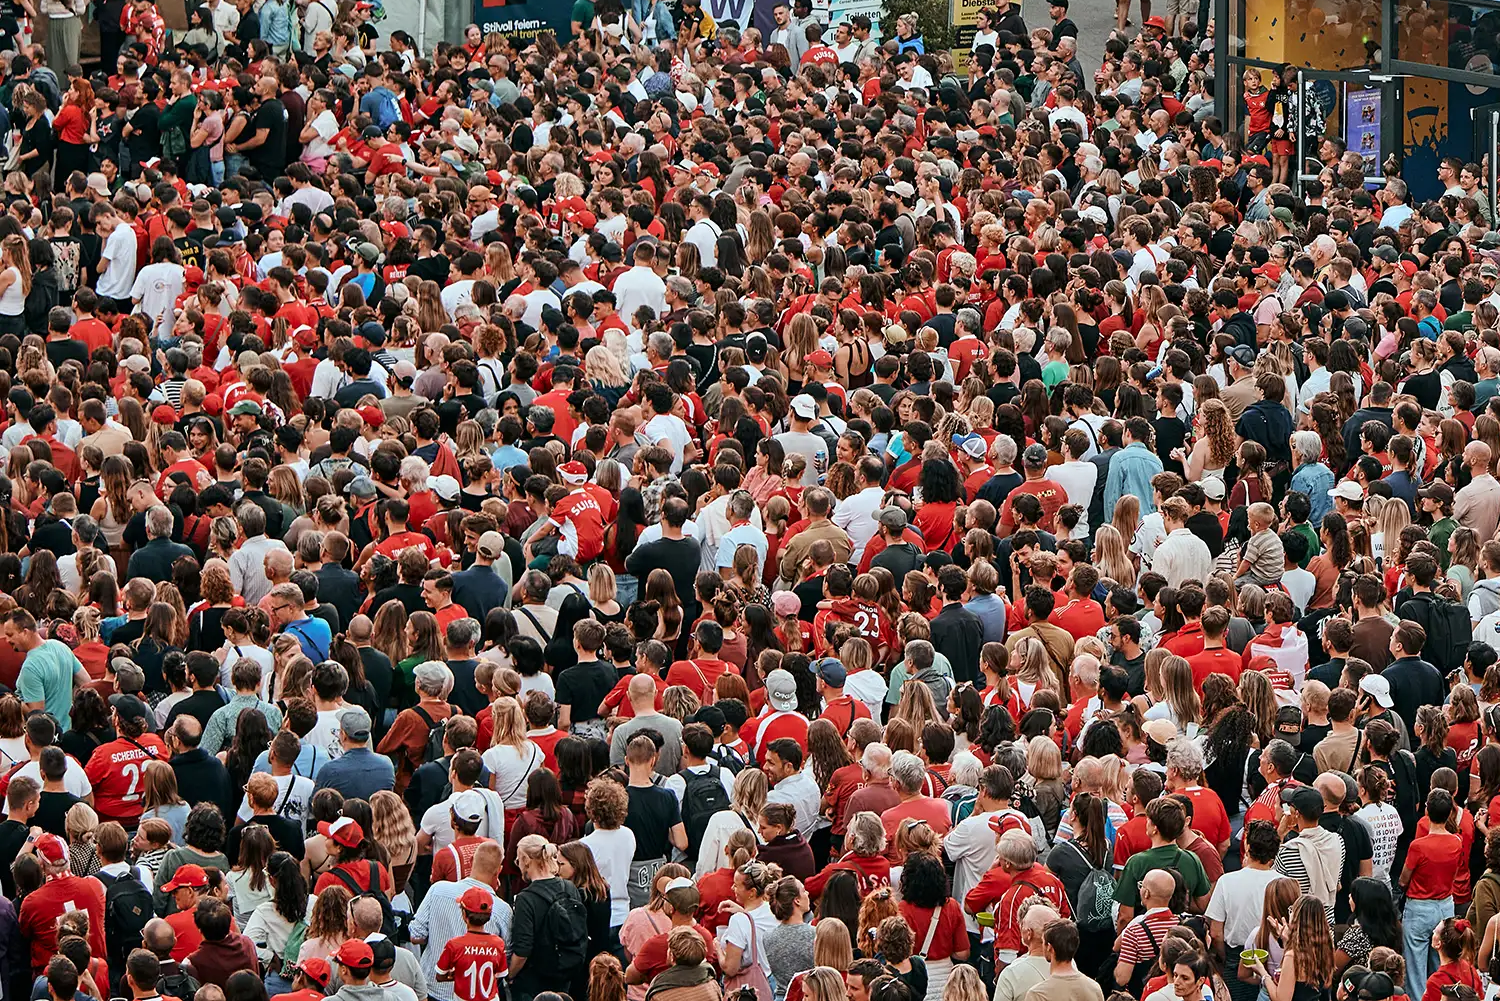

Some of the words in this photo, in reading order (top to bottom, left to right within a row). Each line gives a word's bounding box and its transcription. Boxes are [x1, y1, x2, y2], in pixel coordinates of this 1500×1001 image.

[483, 20, 513, 34] Stilvoll
[514, 18, 540, 29] feiern
[813, 51, 835, 61] SUISSE
[571, 499, 600, 517] SUISS
[854, 612, 879, 638] 23
[464, 945, 498, 956] XHAKA
[464, 960, 494, 999] 10
